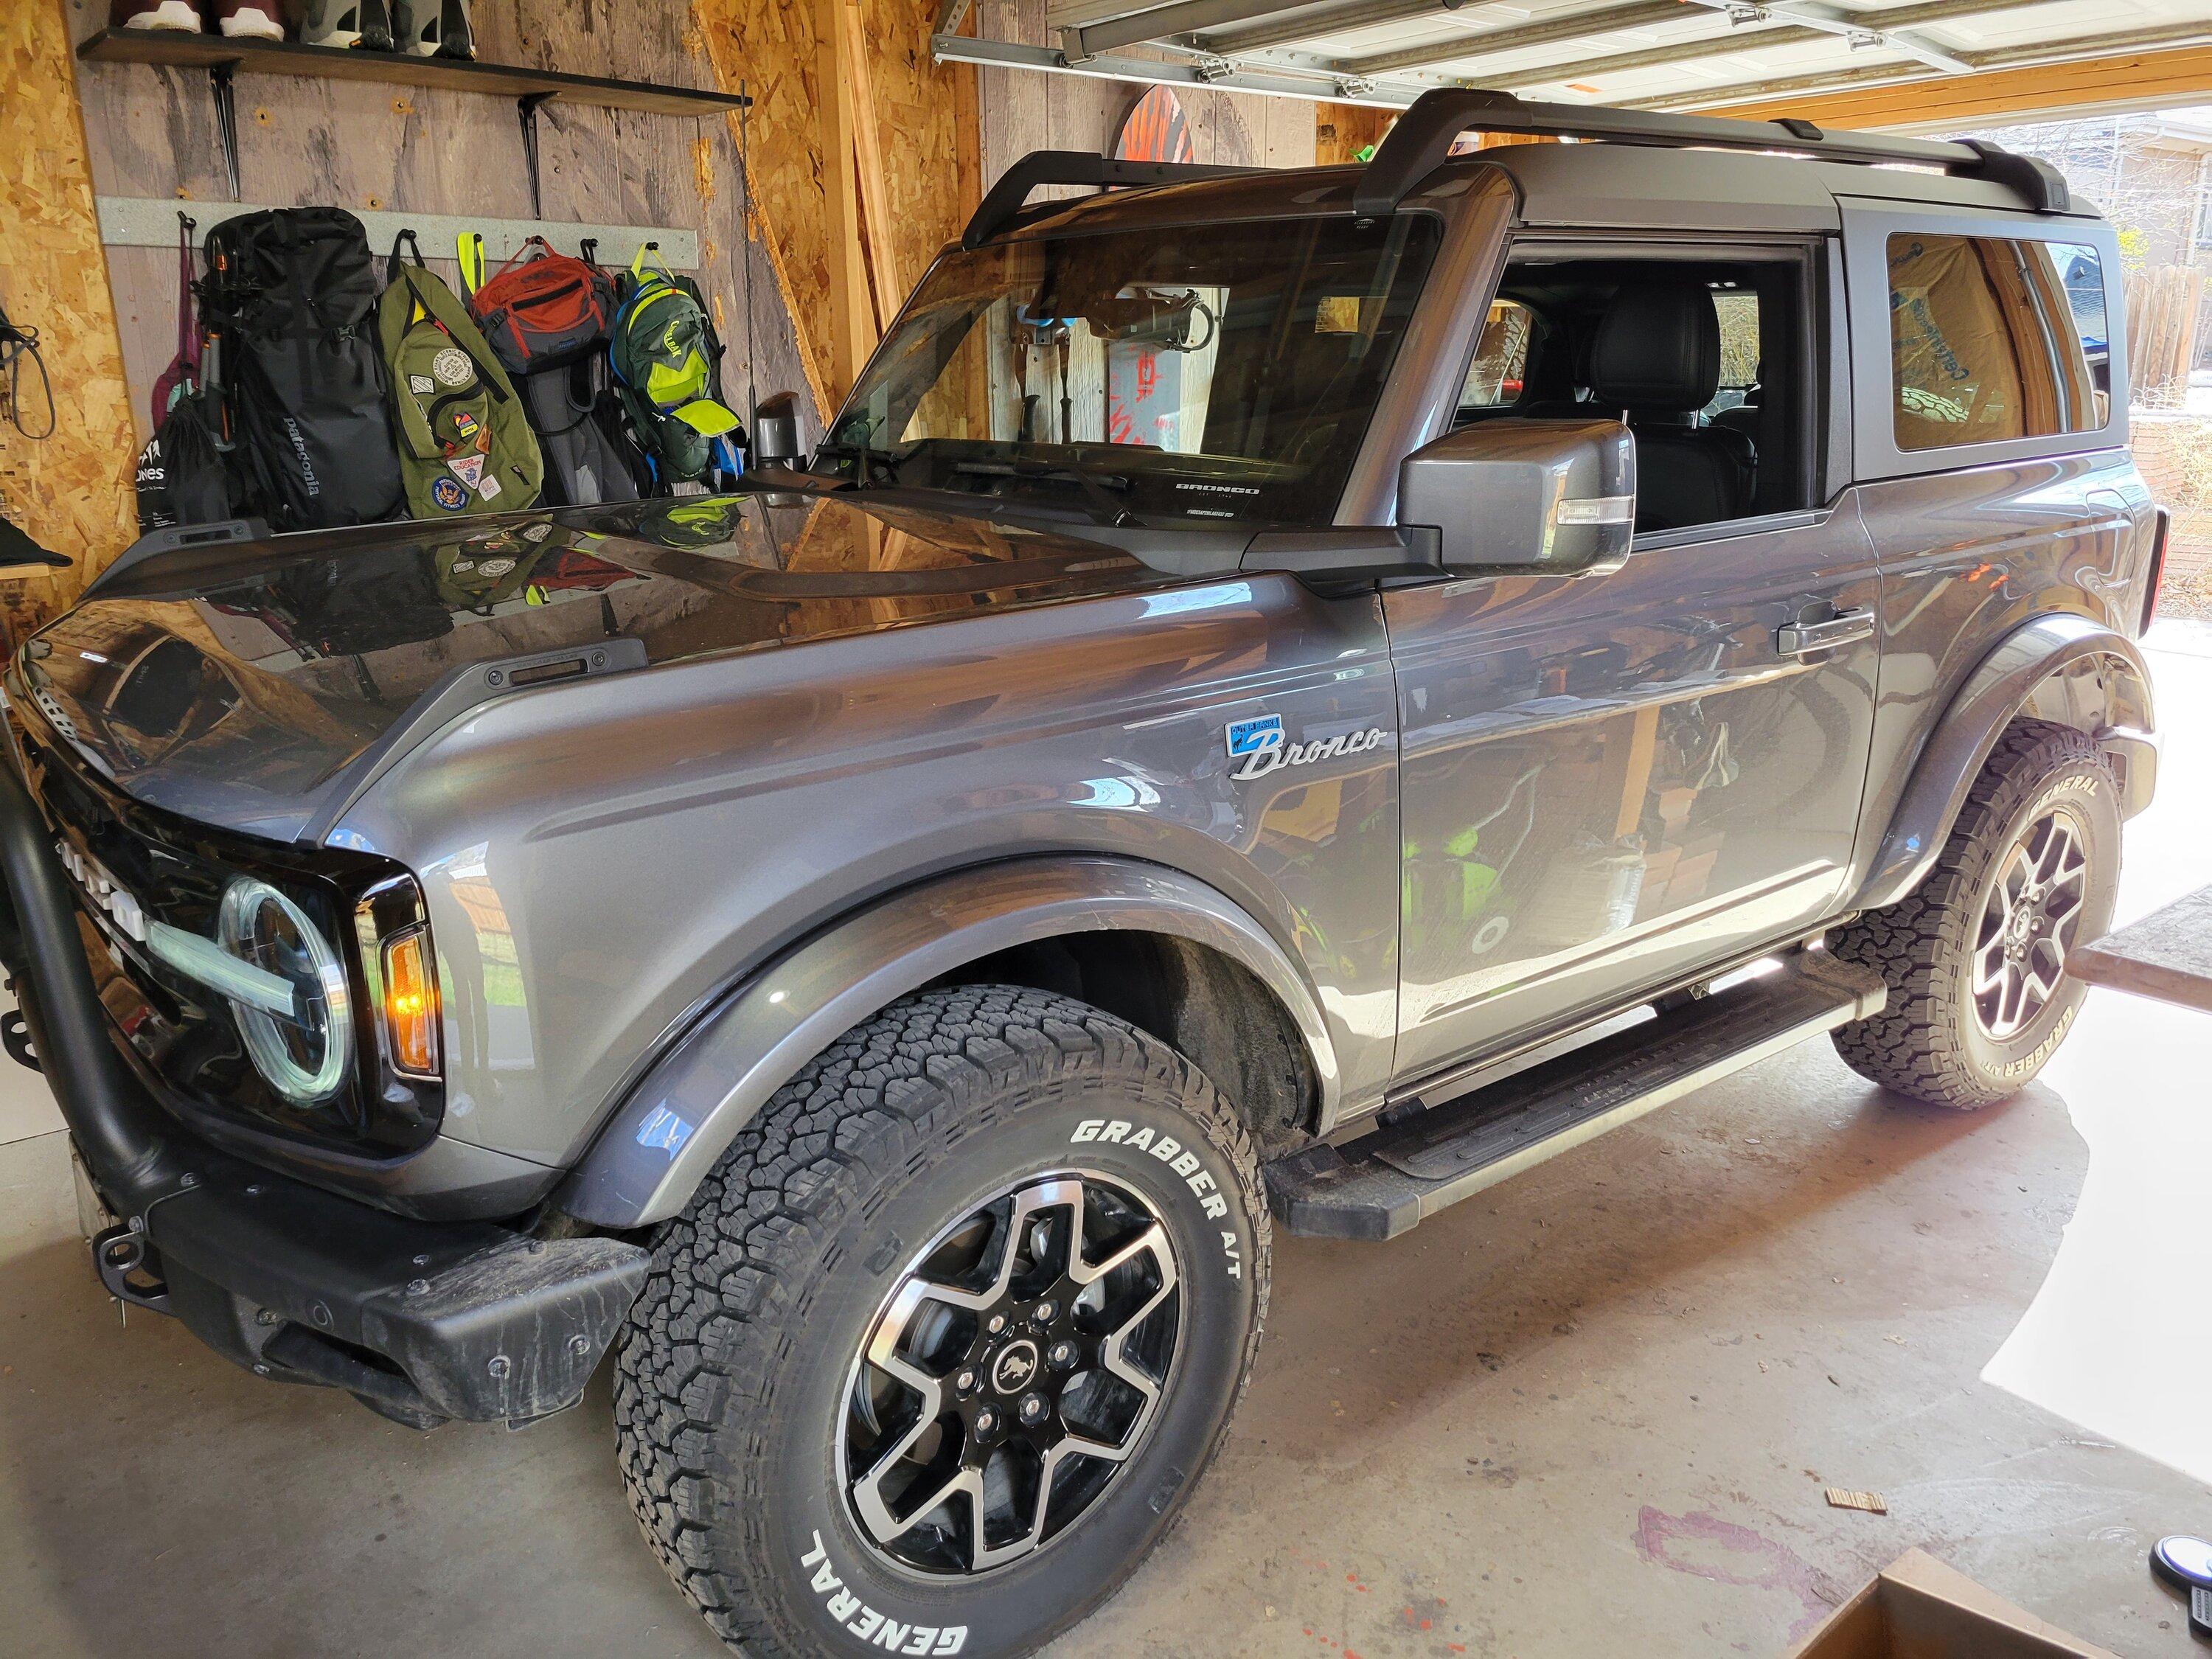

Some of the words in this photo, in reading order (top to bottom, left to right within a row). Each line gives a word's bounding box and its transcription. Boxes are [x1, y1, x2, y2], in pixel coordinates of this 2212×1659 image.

[283, 417, 320, 496] patagonia
[453, 460, 481, 470] EDUCATION
[459, 458, 474, 466] RIDER
[1175, 483, 1260, 495] BRONCO
[1231, 723, 1254, 734] OUTER
[1255, 717, 1280, 729] BANKS
[1230, 728, 1388, 780] Bronco
[2028, 775, 2099, 821] GENERAL
[2003, 1005, 2073, 1077] GRABBER
[1070, 1119, 1228, 1220] GRABBER
[1220, 1231, 1241, 1279] A/T
[800, 1528, 968, 1656] GENERAL
